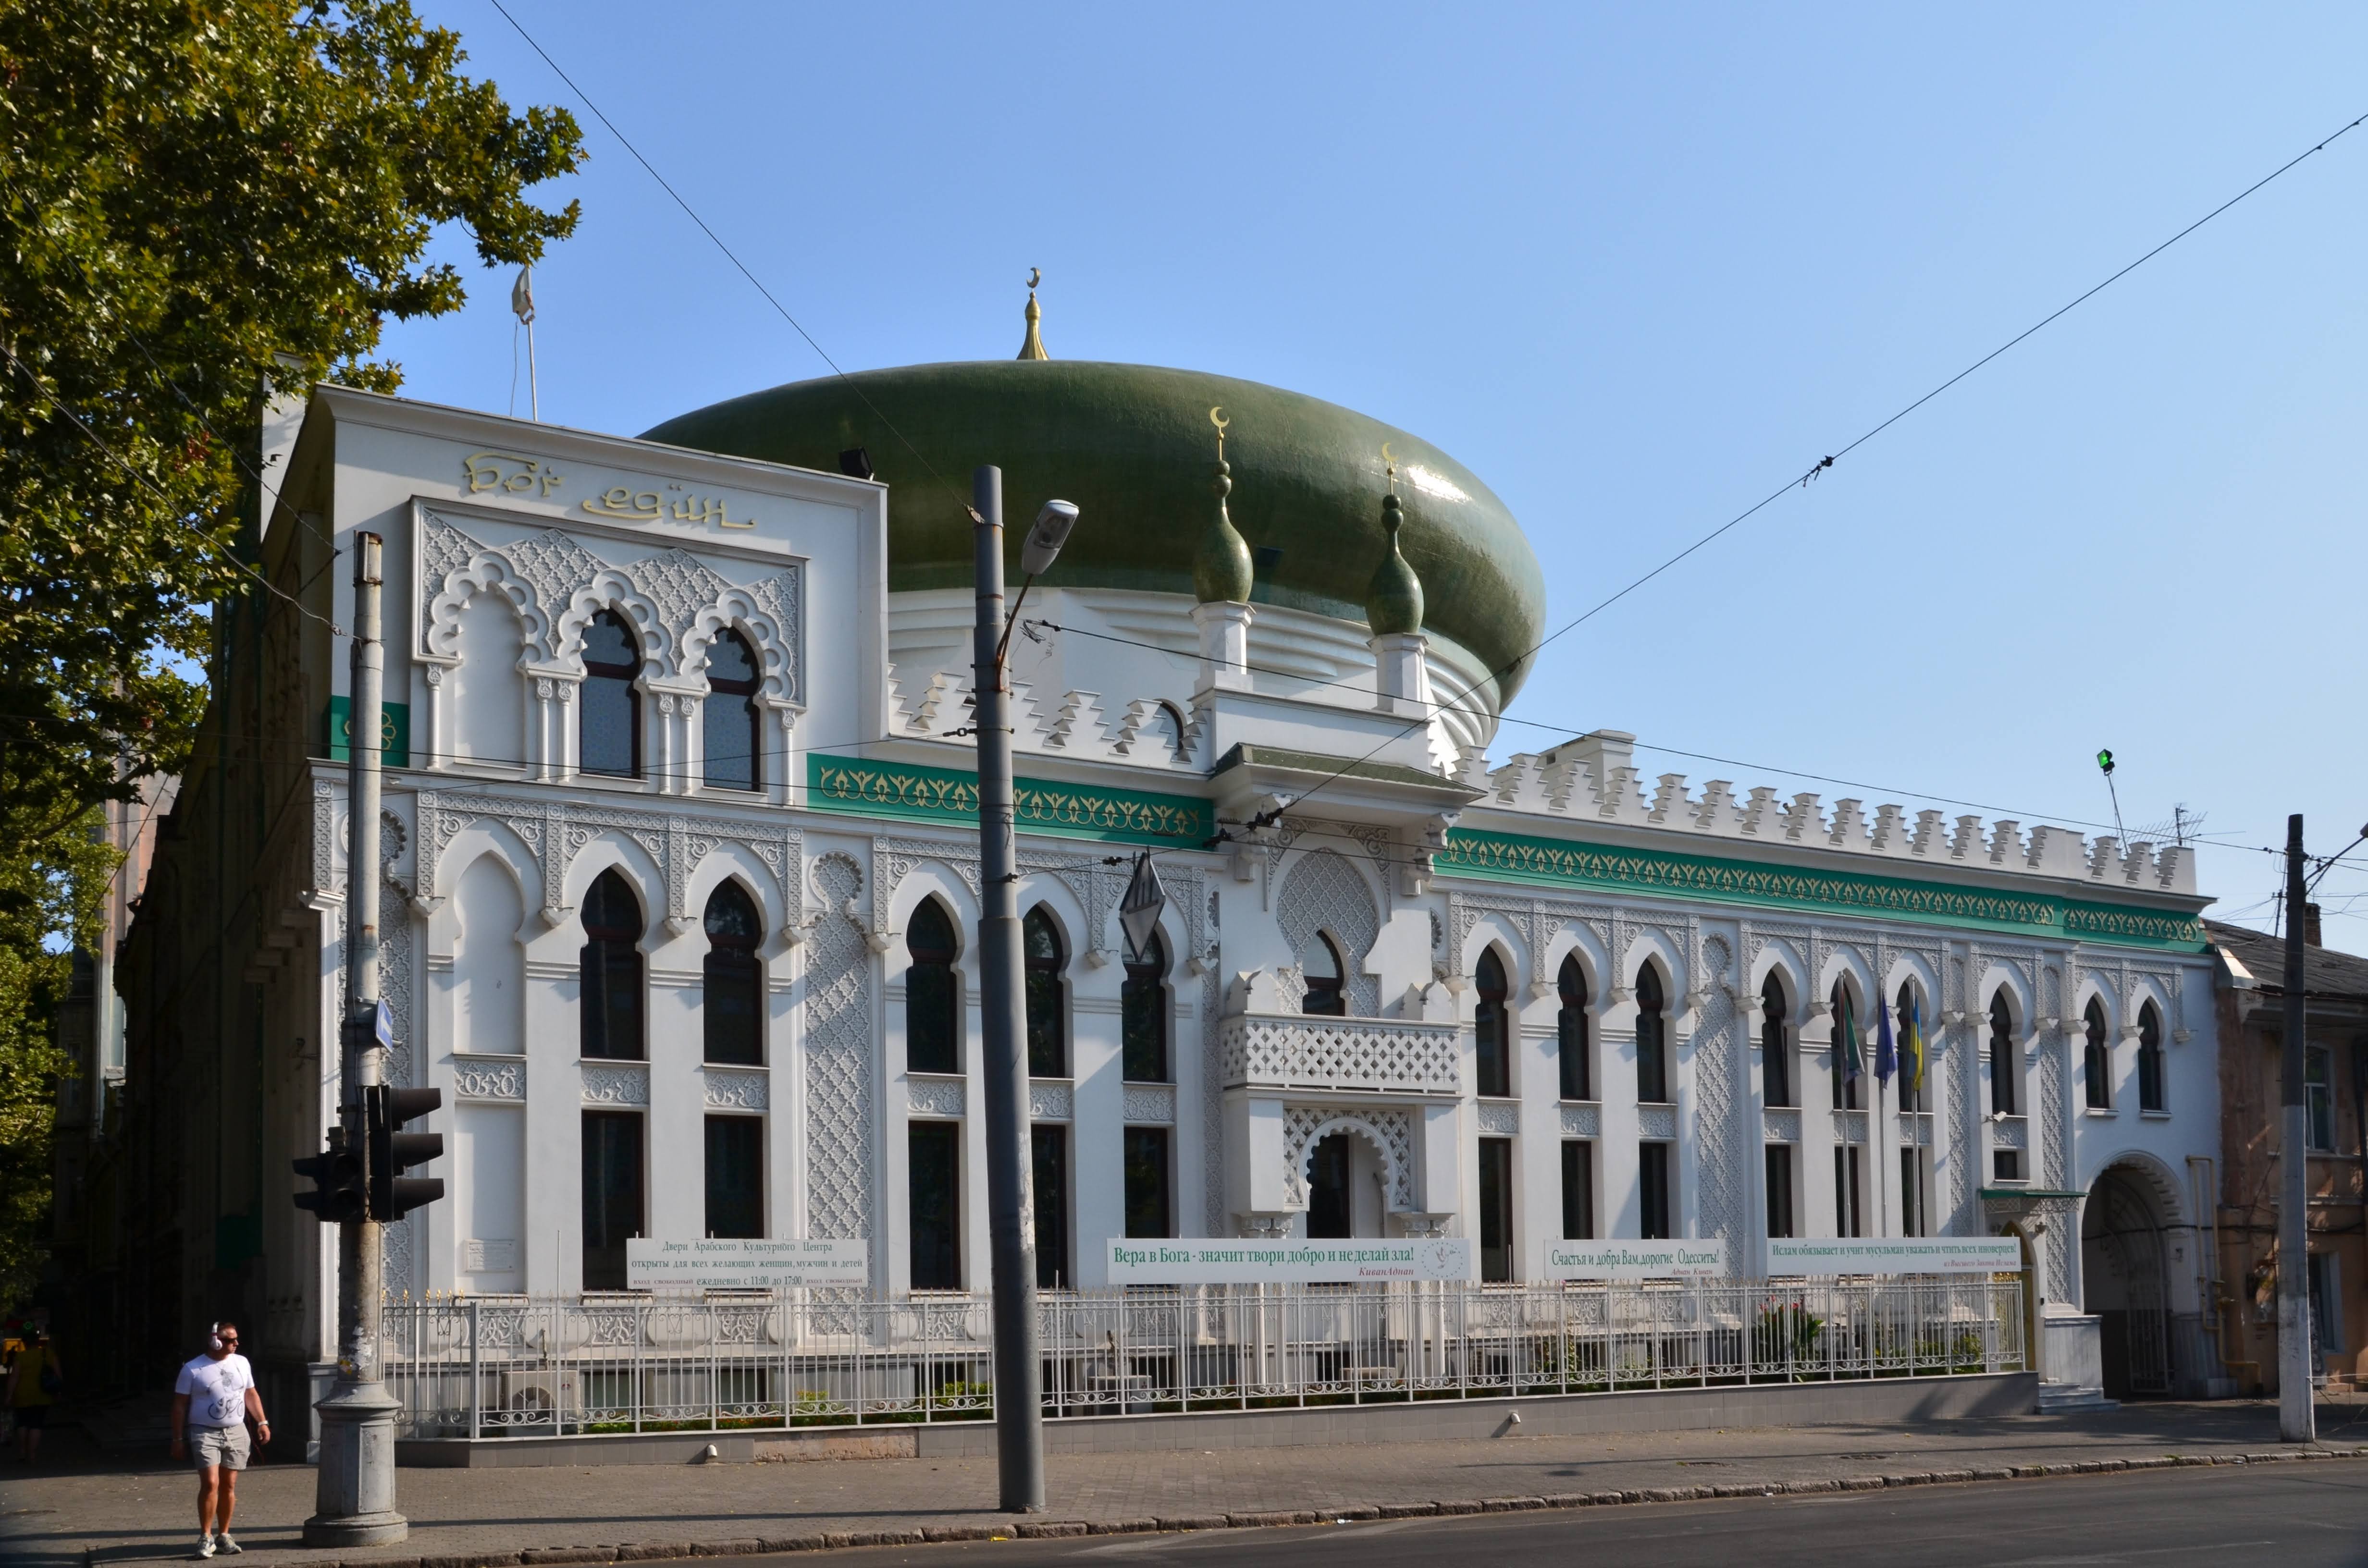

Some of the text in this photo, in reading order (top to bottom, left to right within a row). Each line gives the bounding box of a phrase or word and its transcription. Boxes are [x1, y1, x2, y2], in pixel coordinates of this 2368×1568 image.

[662, 1241, 832, 1254] Двери Арабского Культурного Центра
[1773, 1243, 2017, 1258] Ислам обязывает и учит мусульман уважать и чтить всех иноверцев!
[1114, 1247, 1146, 1267] Вера
[1149, 1251, 1157, 1262] в
[1159, 1247, 1190, 1263] Бога
[1199, 1250, 1245, 1262] значит
[1247, 1250, 1284, 1266] твори
[1287, 1246, 1325, 1266] добро
[1328, 1251, 1336, 1262] и
[1392, 1247, 1414, 1261] зла!
[1552, 1250, 1586, 1266] Счастья
[1588, 1254, 1594, 1265] и
[1596, 1250, 1620, 1270] добра
[1678, 1248, 1719, 1267] Одесситы!
[631, 1261, 669, 1270] открыты
[841, 1259, 863, 1268] детей
[697, 1278, 741, 1286] ежедневно
[751, 1275, 769, 1285] 11:00
[772, 1278, 782, 1286] до
[784, 1275, 802, 1285] 17:00
